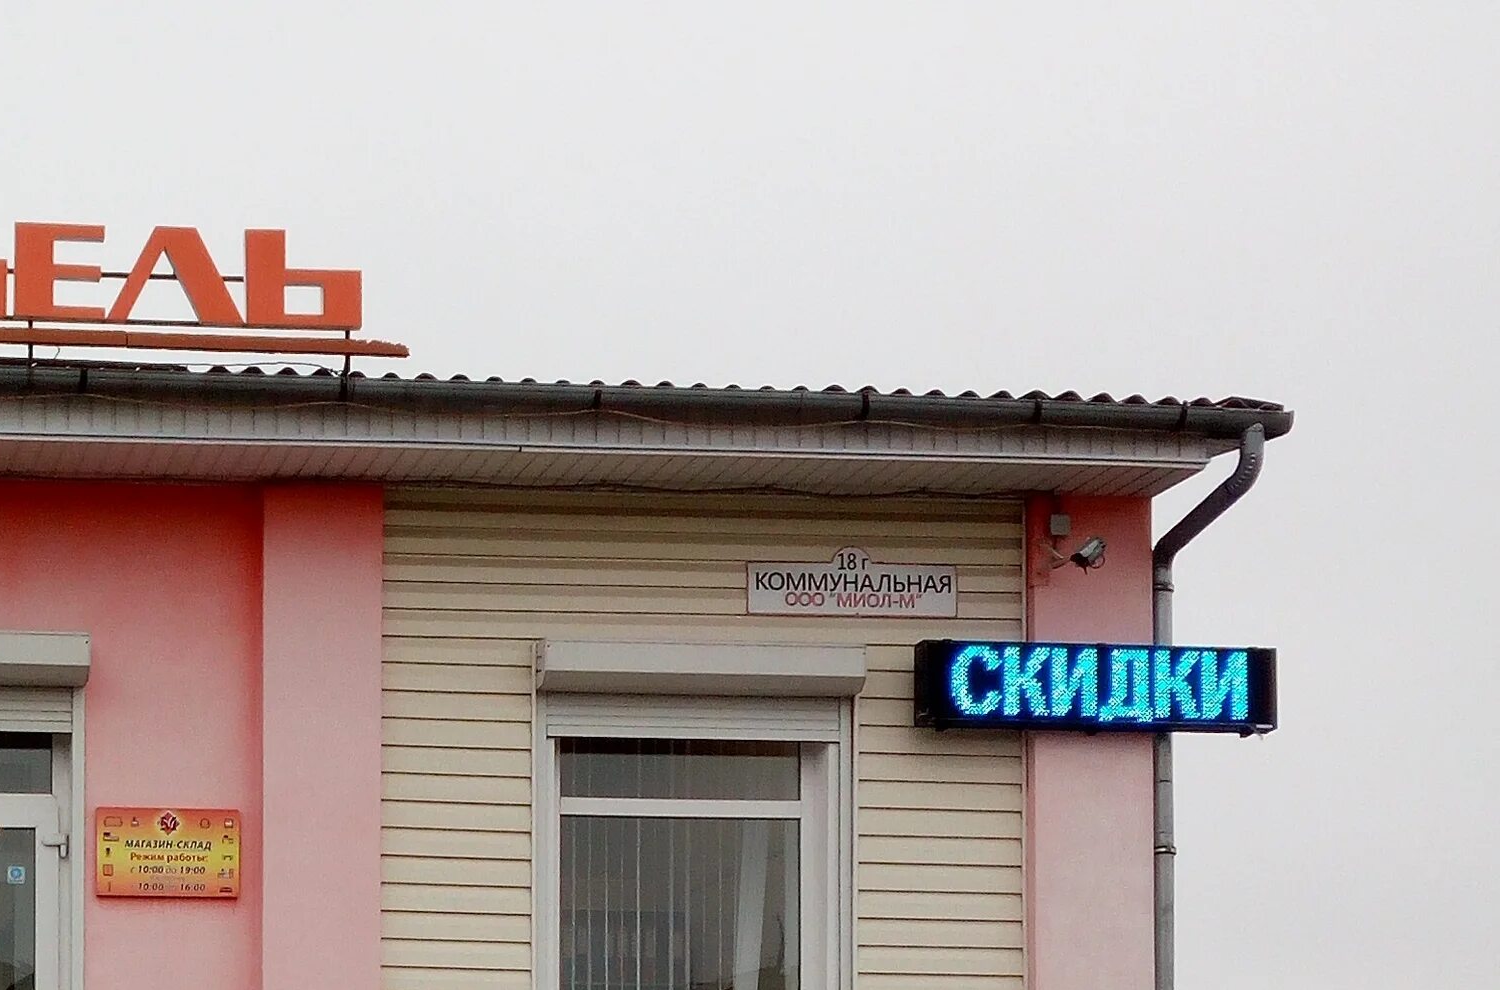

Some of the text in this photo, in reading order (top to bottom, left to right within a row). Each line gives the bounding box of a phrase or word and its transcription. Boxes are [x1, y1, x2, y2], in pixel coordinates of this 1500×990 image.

[836, 552, 869, 570] 18 г
[755, 571, 952, 593] КОММУНАЛЬНАЯ
[785, 592, 825, 607] ООО
[950, 645, 1249, 723] СКИДКИ
[130, 852, 208, 863] Режим работы:
[138, 865, 164, 874] 10:00
[180, 866, 206, 874] 19:00
[138, 882, 206, 891] 10:00 16:00
